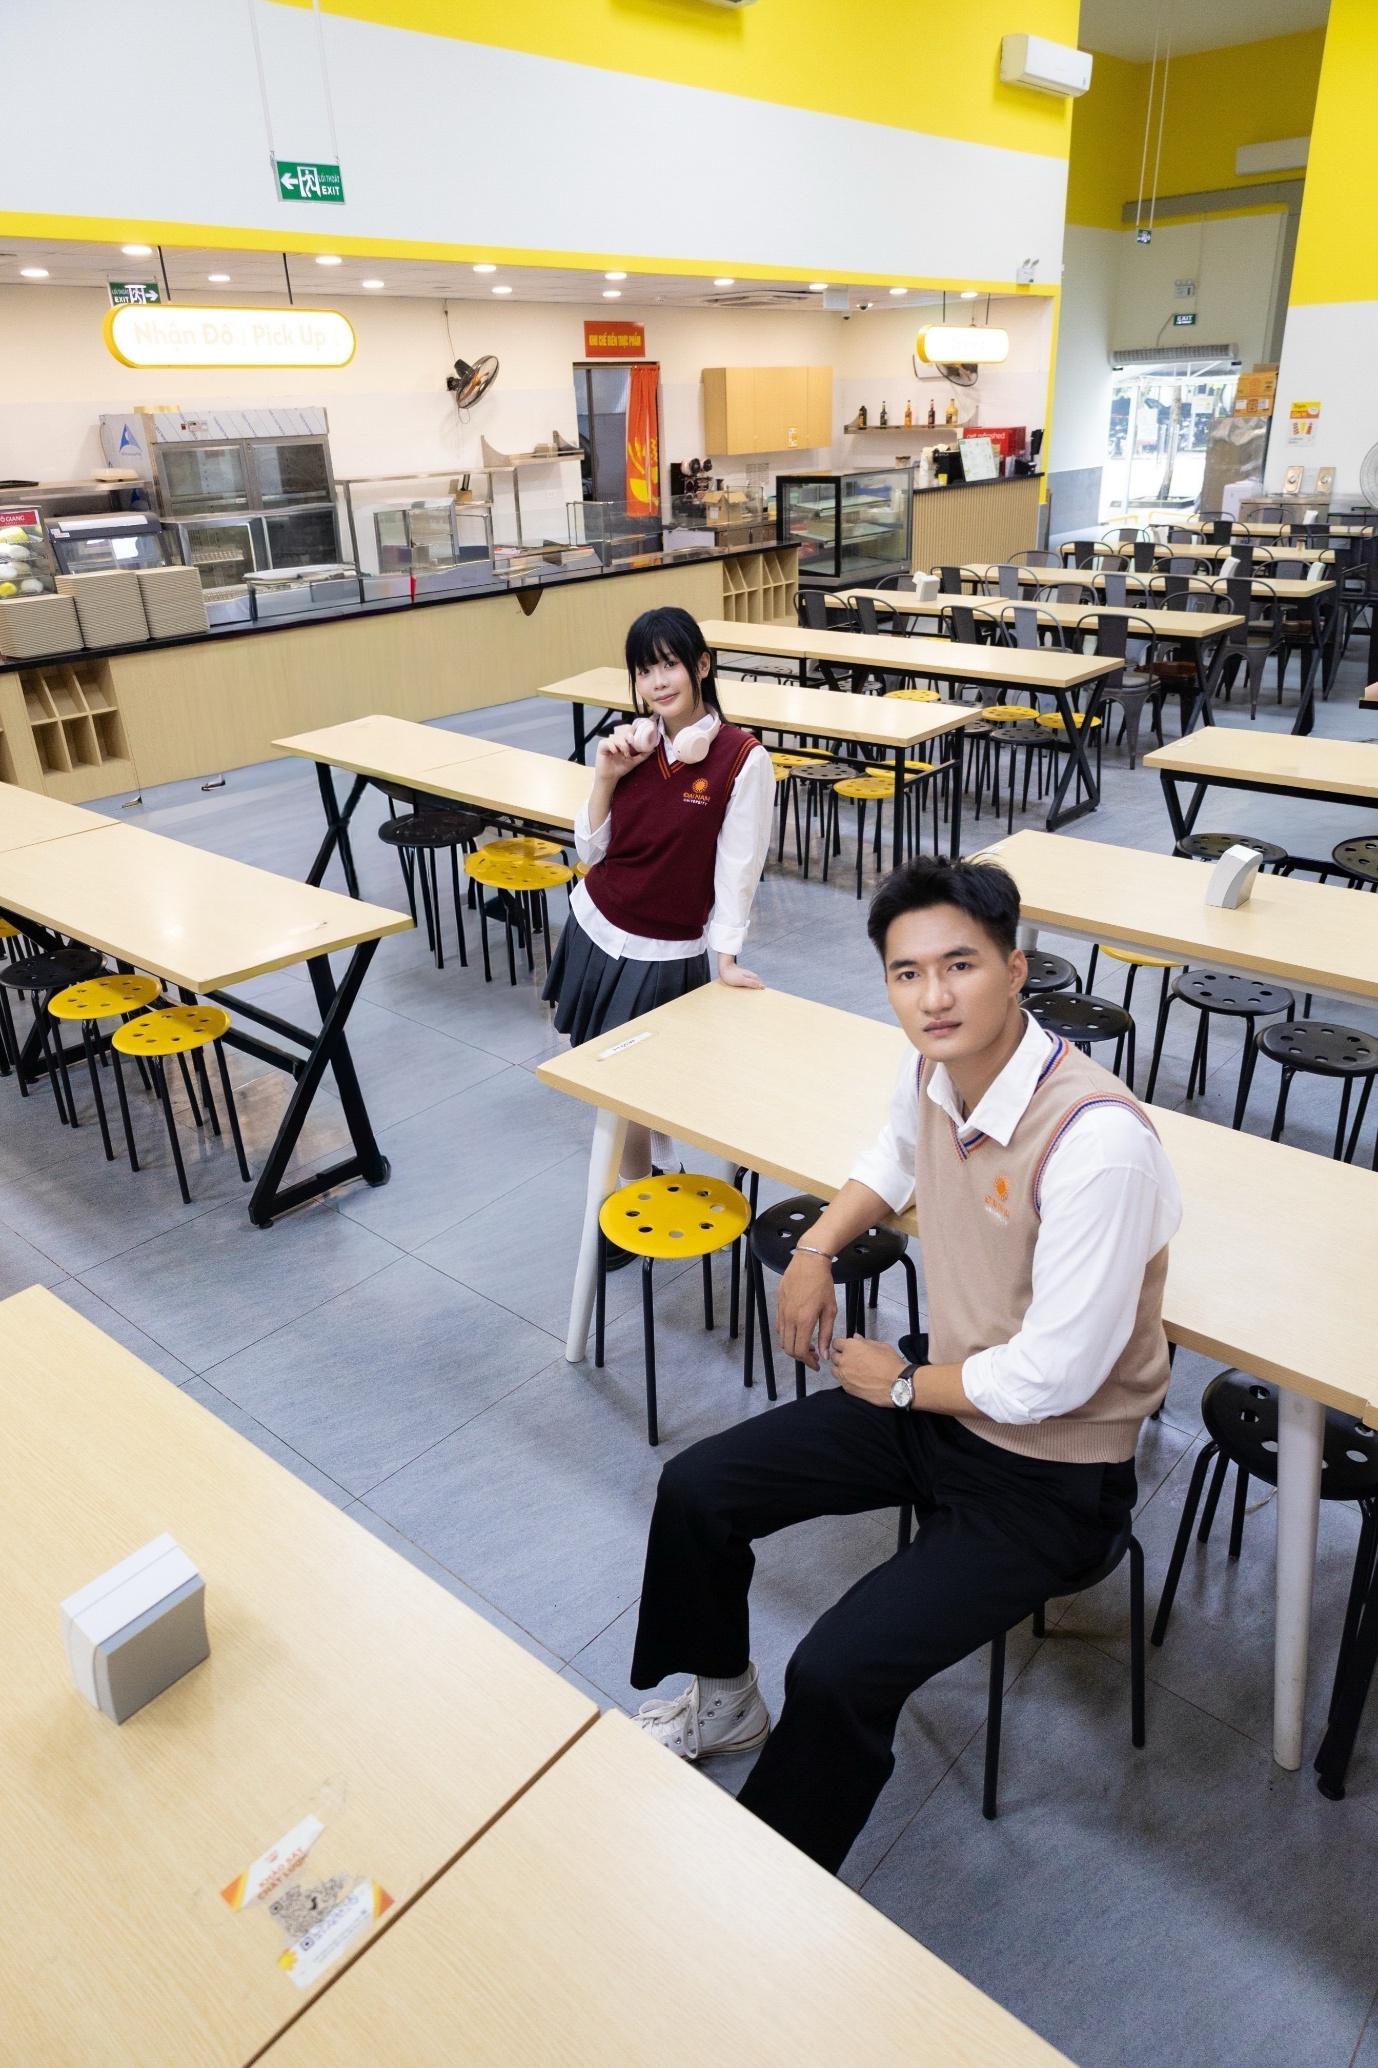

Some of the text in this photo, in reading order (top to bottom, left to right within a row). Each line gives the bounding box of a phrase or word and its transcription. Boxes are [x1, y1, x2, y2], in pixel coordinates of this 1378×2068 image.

[321, 186, 340, 196] EXIT
[132, 320, 196, 352] Nhận
[252, 323, 294, 346] Pick
[299, 324, 327, 352] Up
